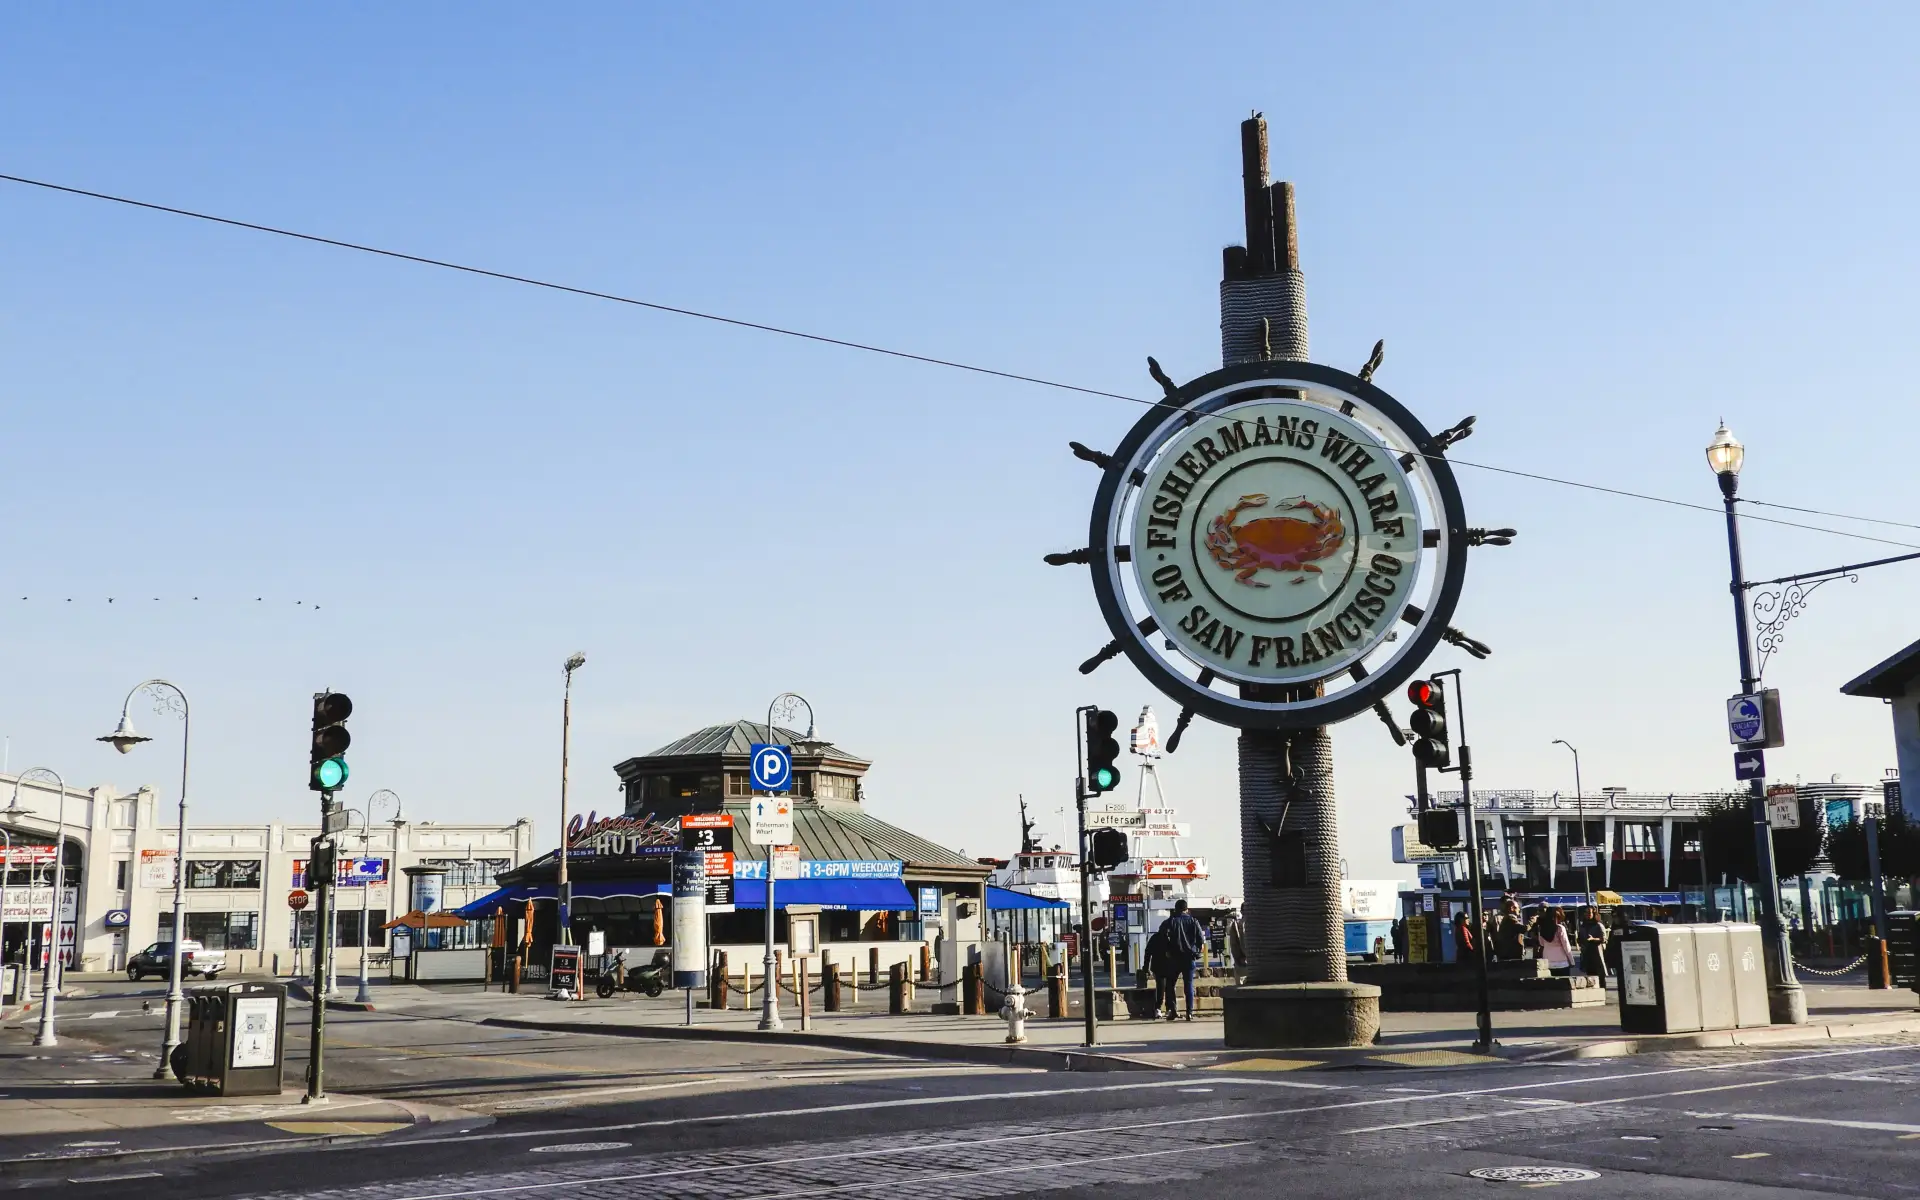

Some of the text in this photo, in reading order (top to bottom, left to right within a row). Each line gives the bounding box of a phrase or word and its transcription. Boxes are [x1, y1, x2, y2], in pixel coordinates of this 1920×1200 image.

[1147, 415, 1405, 549] FISHERMANS WHARF
[1151, 553, 1404, 669] OF SAN FRANCISCO
[1776, 805, 1789, 814] ANY
[1093, 815, 1141, 825] Jefferson
[1777, 813, 1791, 821] TIME
[755, 821, 790, 829] Fisherman's
[698, 829, 715, 846] $3
[596, 834, 642, 855] HUT
[644, 846, 682, 854] GRILL
[814, 862, 900, 877] 3-6PM WEEKDAYS
[289, 896, 308, 904] STOP
